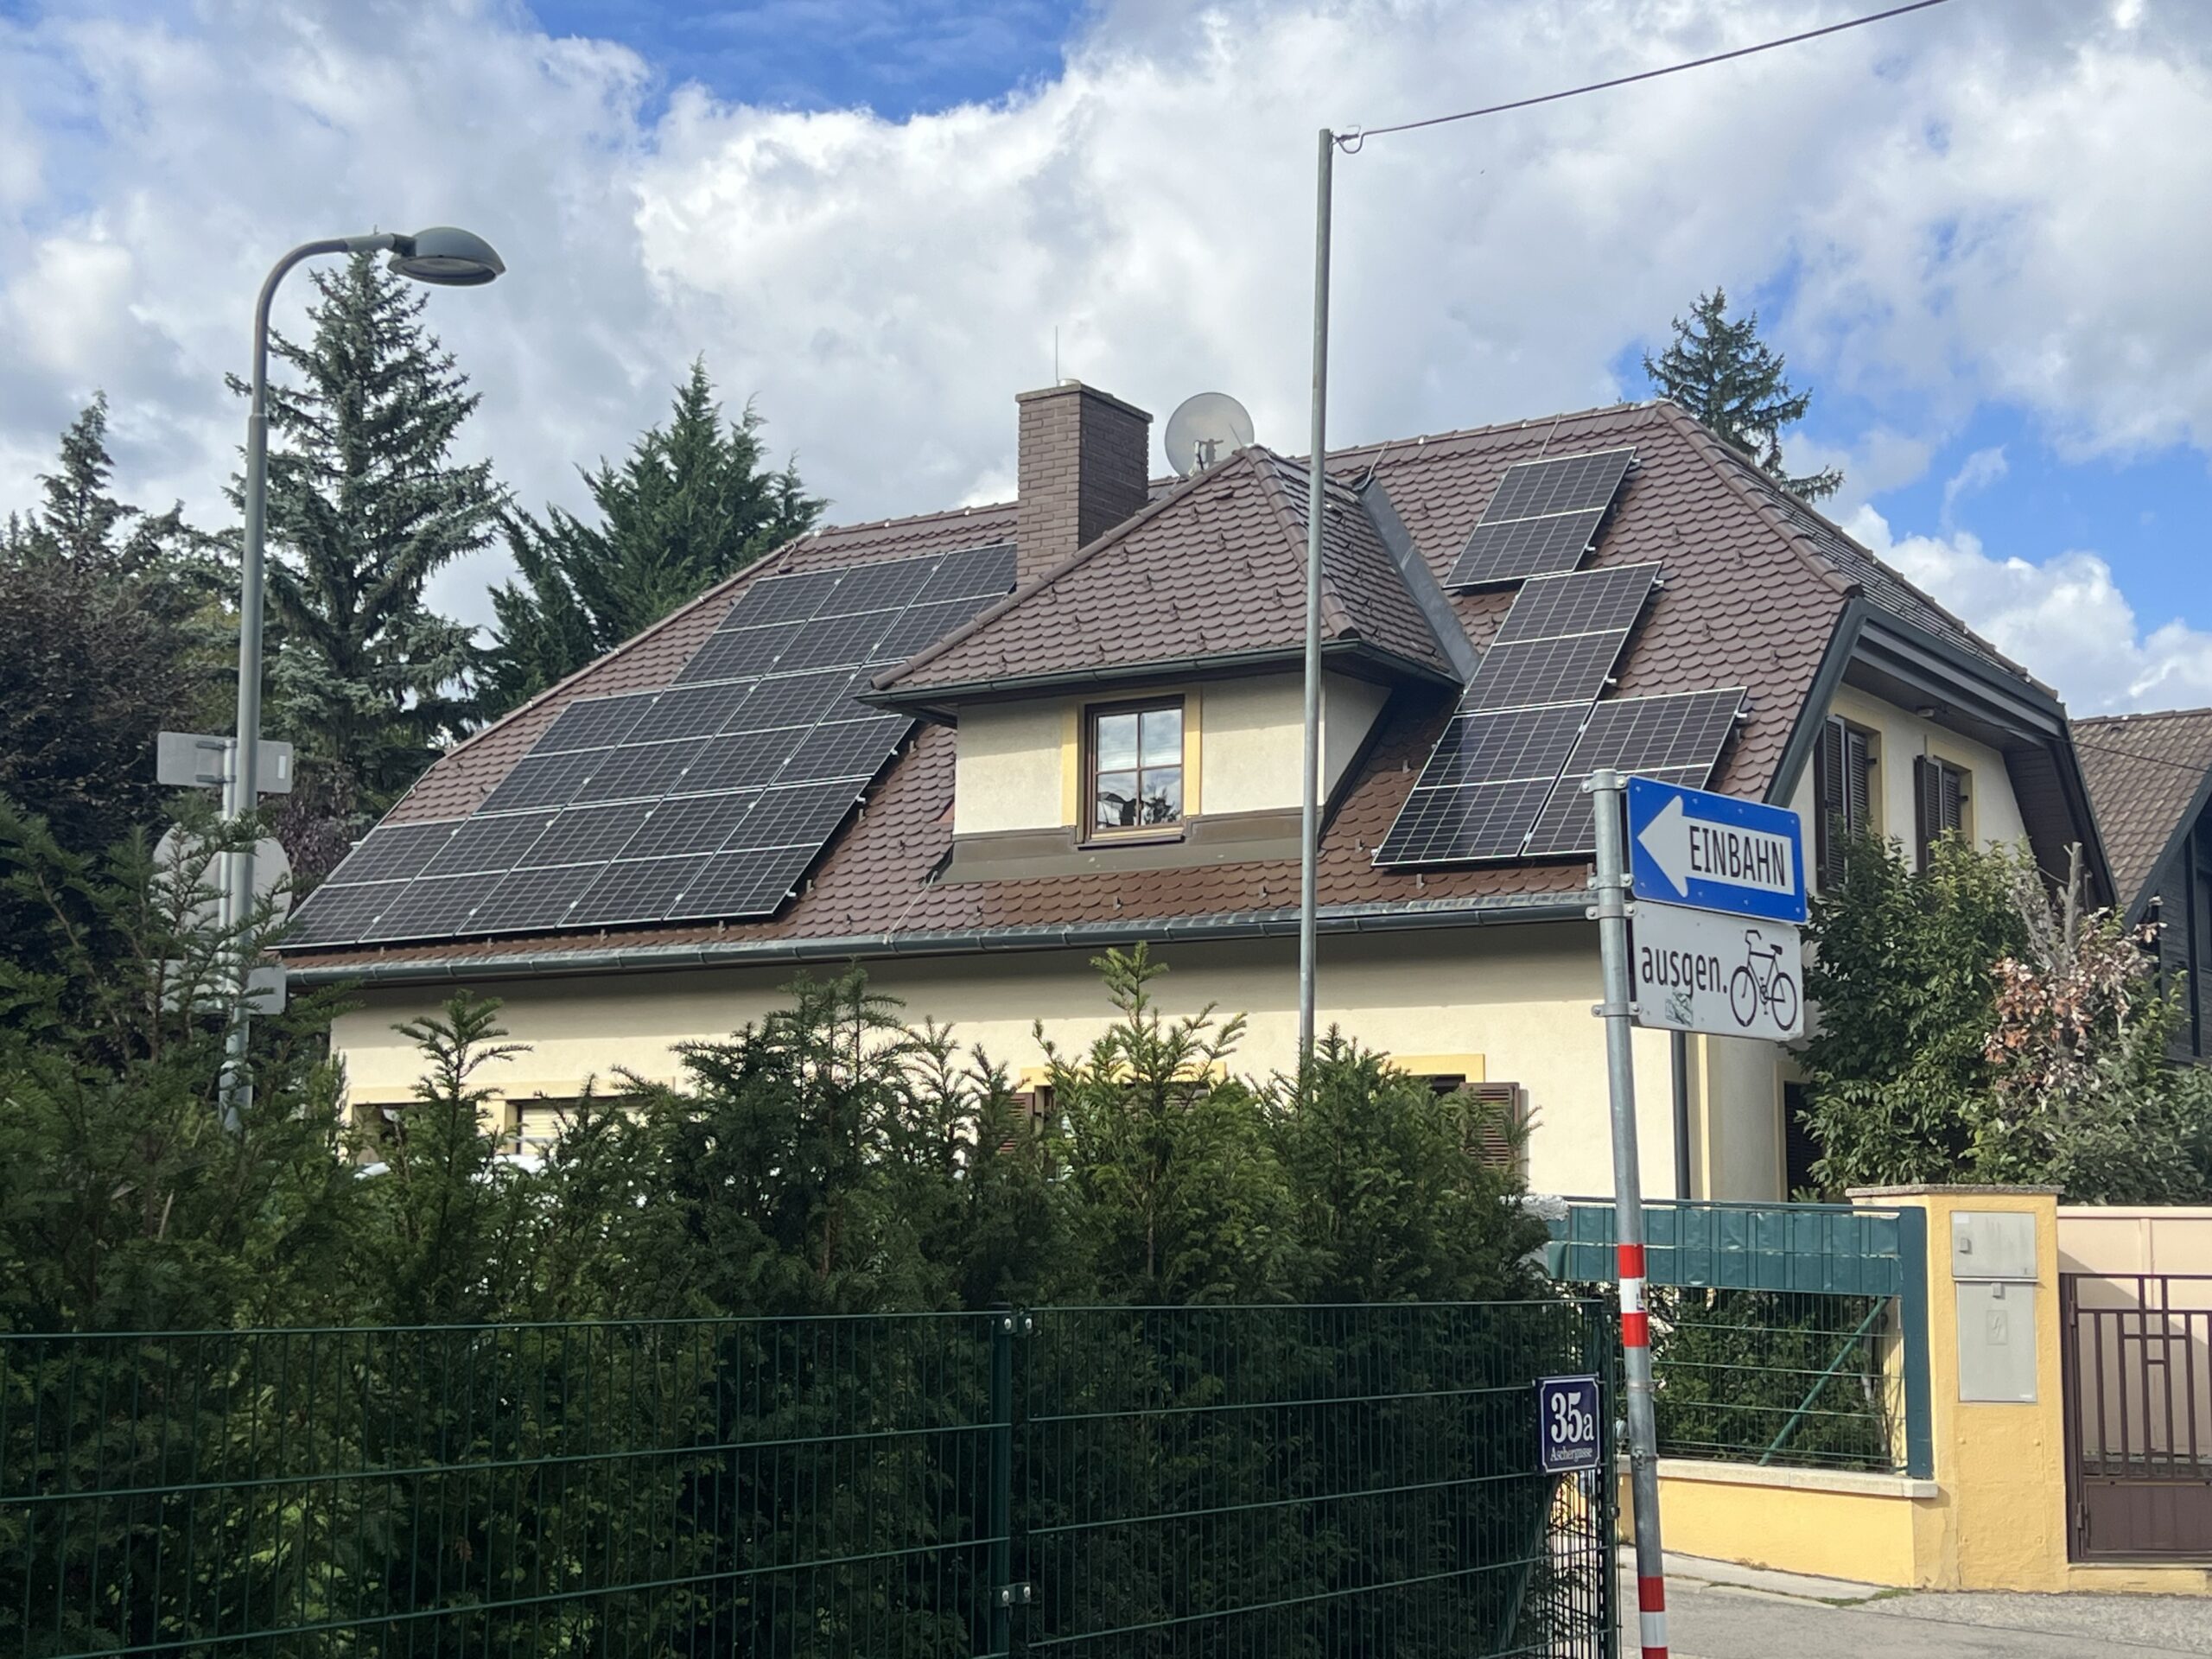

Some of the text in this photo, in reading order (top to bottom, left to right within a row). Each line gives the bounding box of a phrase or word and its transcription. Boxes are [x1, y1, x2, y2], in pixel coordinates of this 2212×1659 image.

[1688, 825, 1786, 887] EINBAHN
[1642, 946, 1727, 995] ausgen.
[1550, 1391, 1595, 1444] 35a
